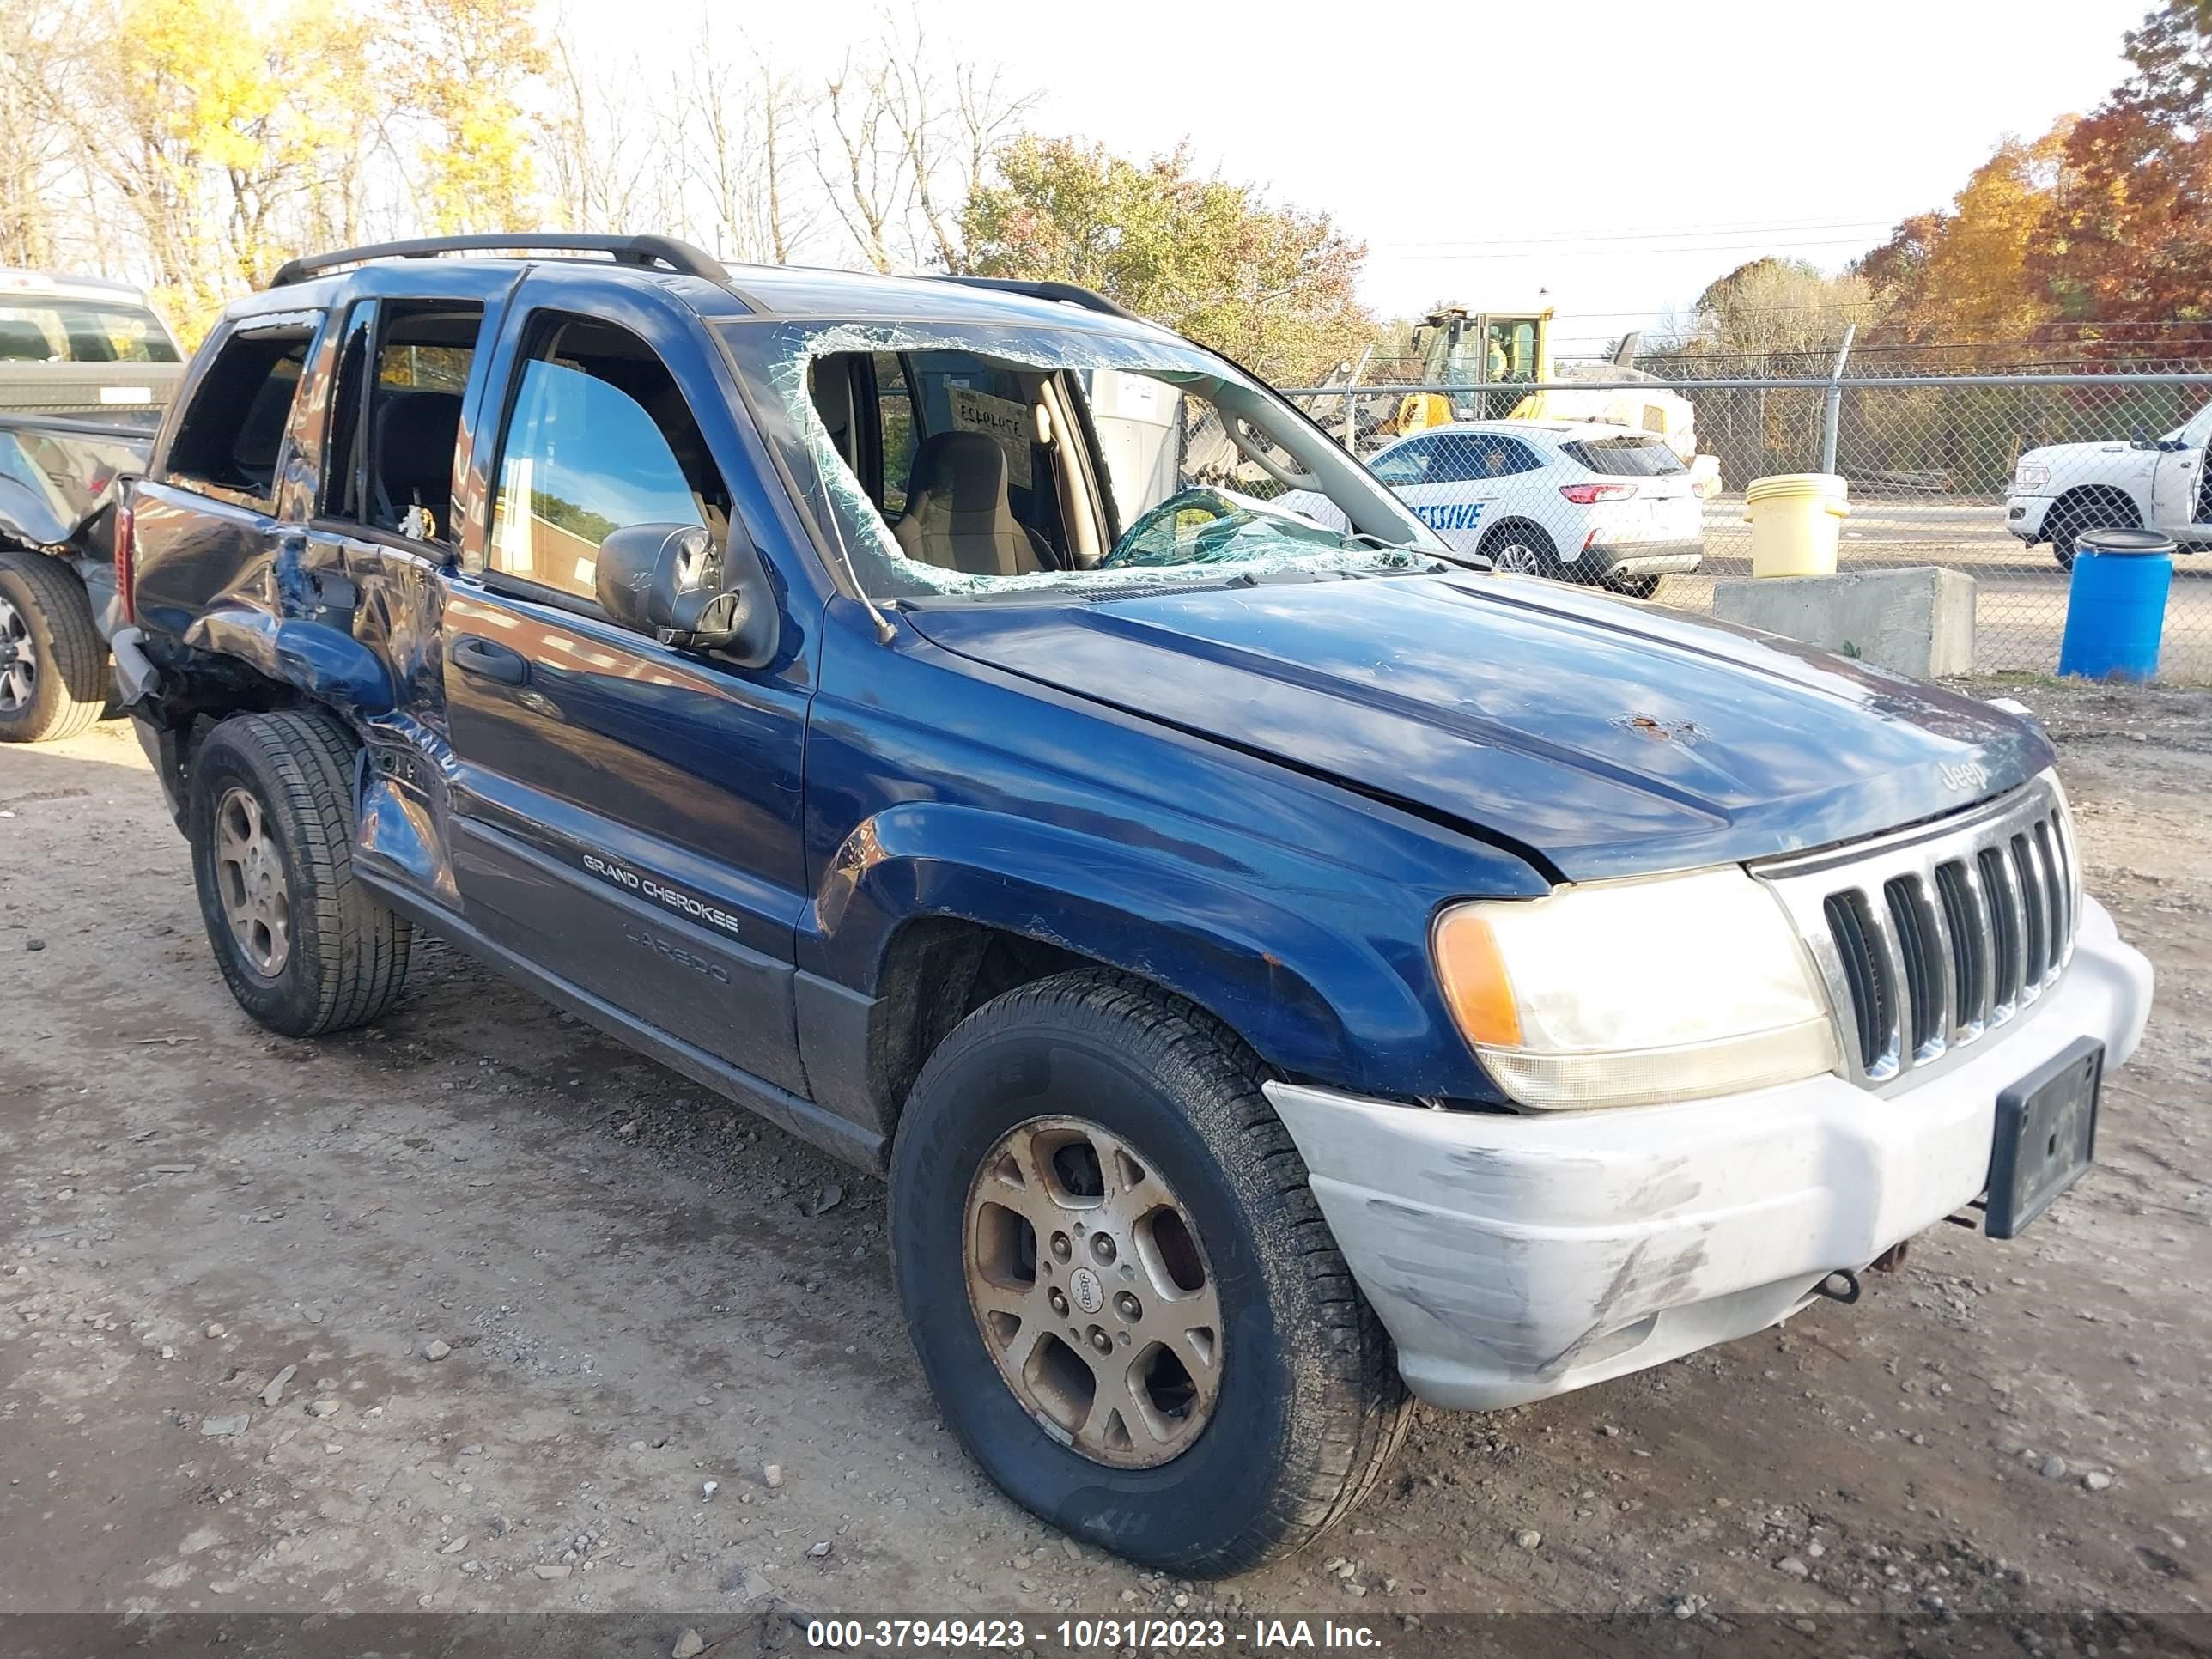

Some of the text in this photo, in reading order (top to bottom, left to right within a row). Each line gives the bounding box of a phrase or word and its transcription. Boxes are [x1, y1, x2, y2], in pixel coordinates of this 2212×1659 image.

[1937, 762, 1988, 791] Jeep
[583, 854, 739, 933] GRAND CHEROKEE
[623, 922, 730, 984] LAREDO
[1079, 1272, 1093, 1309] Jeep
